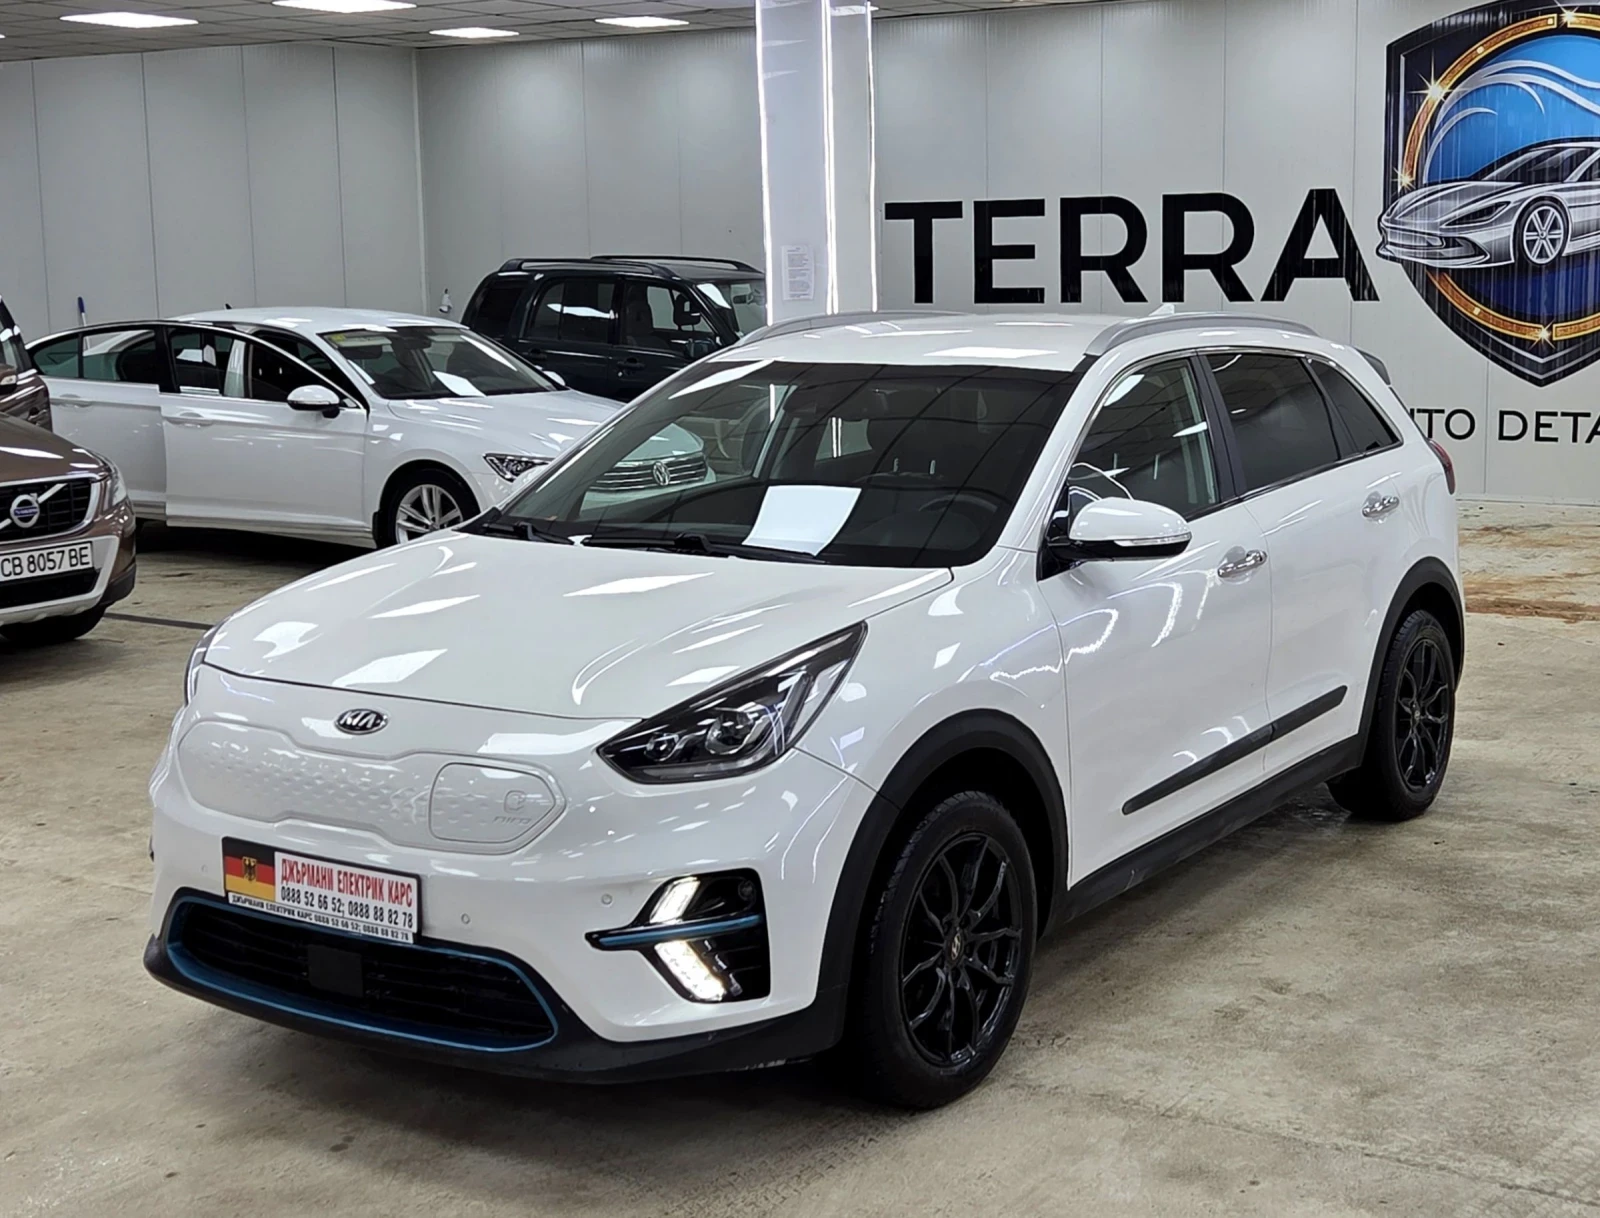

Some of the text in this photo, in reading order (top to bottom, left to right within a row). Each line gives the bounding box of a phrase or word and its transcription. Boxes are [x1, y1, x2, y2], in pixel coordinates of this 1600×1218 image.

[885, 188, 1380, 304] TERRA
[1410, 408, 1476, 440] TO
[1, 546, 90, 577] CB 8057 BE
[340, 710, 377, 728] KIA
[281, 858, 413, 908] ДЖЪРМАНИ ЕЛЕКТРИК КАРС
[281, 886, 413, 929] 0888 52 66 52; 0888 88 82 78
